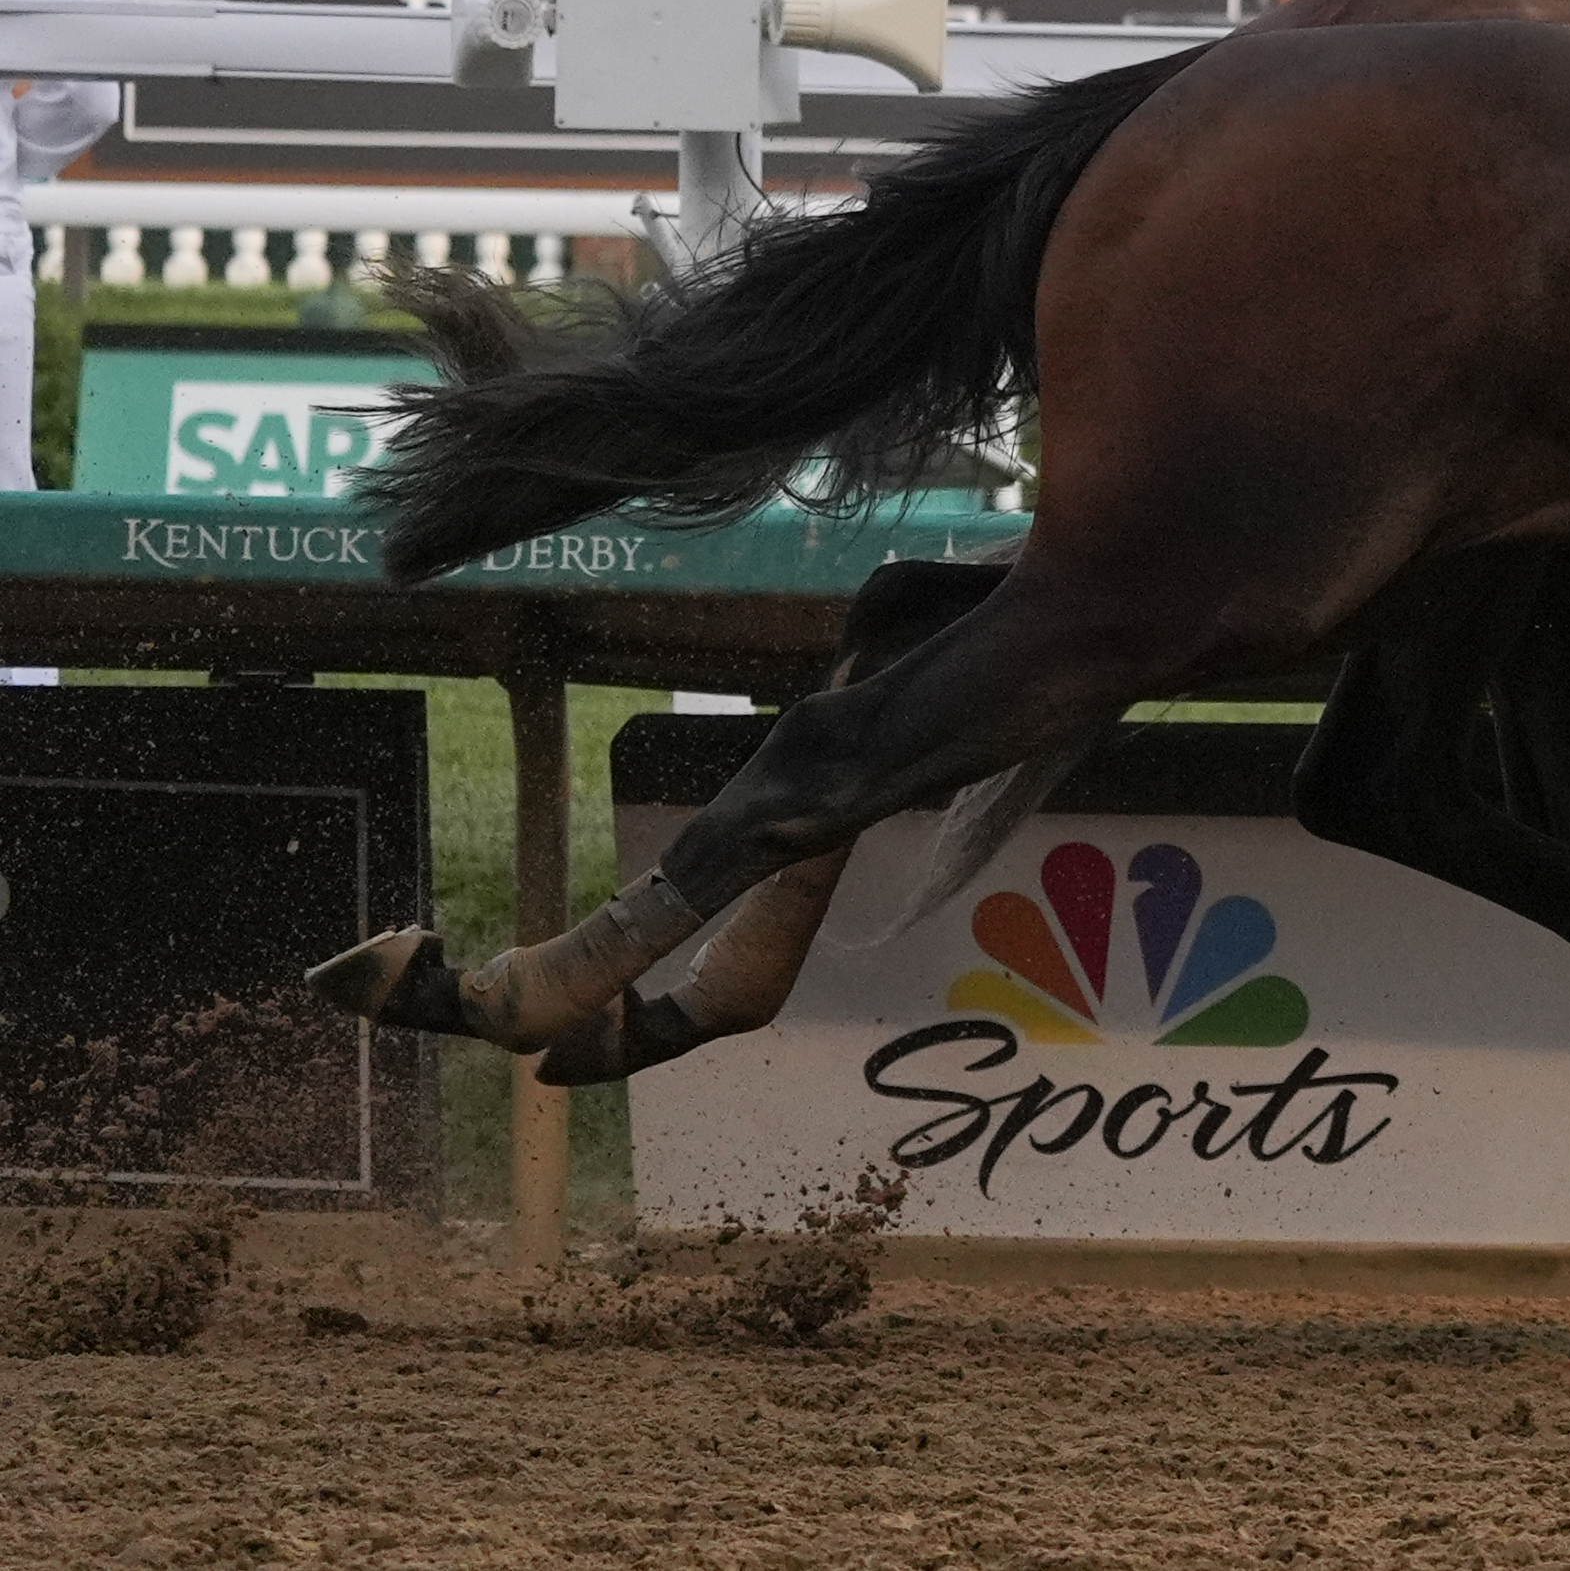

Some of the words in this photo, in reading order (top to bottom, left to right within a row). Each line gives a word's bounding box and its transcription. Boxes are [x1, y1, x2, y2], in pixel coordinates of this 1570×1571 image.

[175, 410, 374, 497] SAP
[122, 517, 384, 569] KENTUCK
[863, 1020, 1399, 1202] Sports
